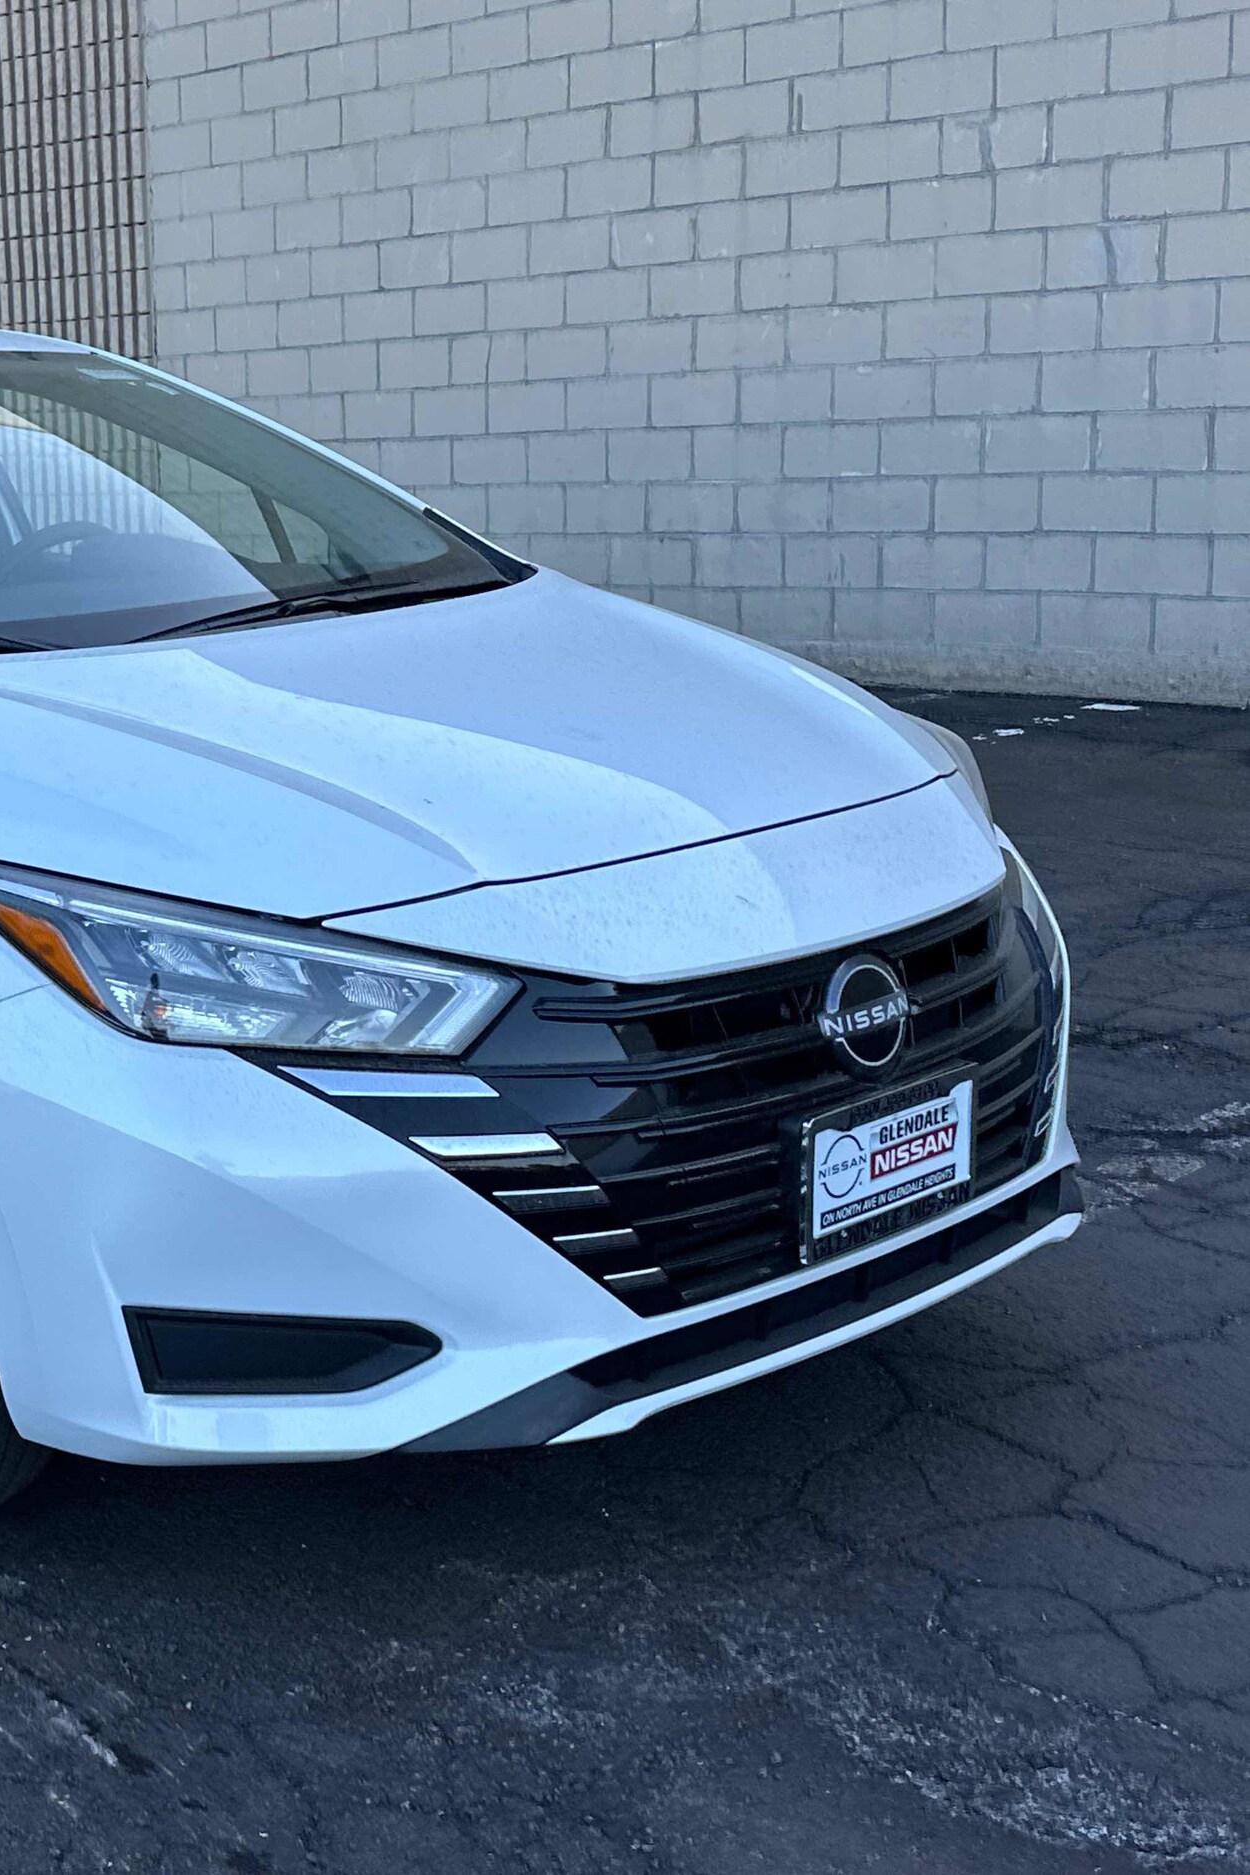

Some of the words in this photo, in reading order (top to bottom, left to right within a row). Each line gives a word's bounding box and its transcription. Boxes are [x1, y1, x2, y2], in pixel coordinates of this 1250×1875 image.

[824, 995, 909, 1037] NISSAN
[879, 1105, 949, 1146] GLENDALE
[818, 1154, 867, 1179] NISSAN
[875, 1127, 954, 1175] NISSAN
[822, 1210, 836, 1226] ON
[834, 1202, 863, 1222] NORTH
[861, 1196, 878, 1213] AVE
[877, 1193, 888, 1207] IN
[886, 1178, 925, 1203] GLENDALE
[923, 1166, 956, 1190] HEIGHTS
